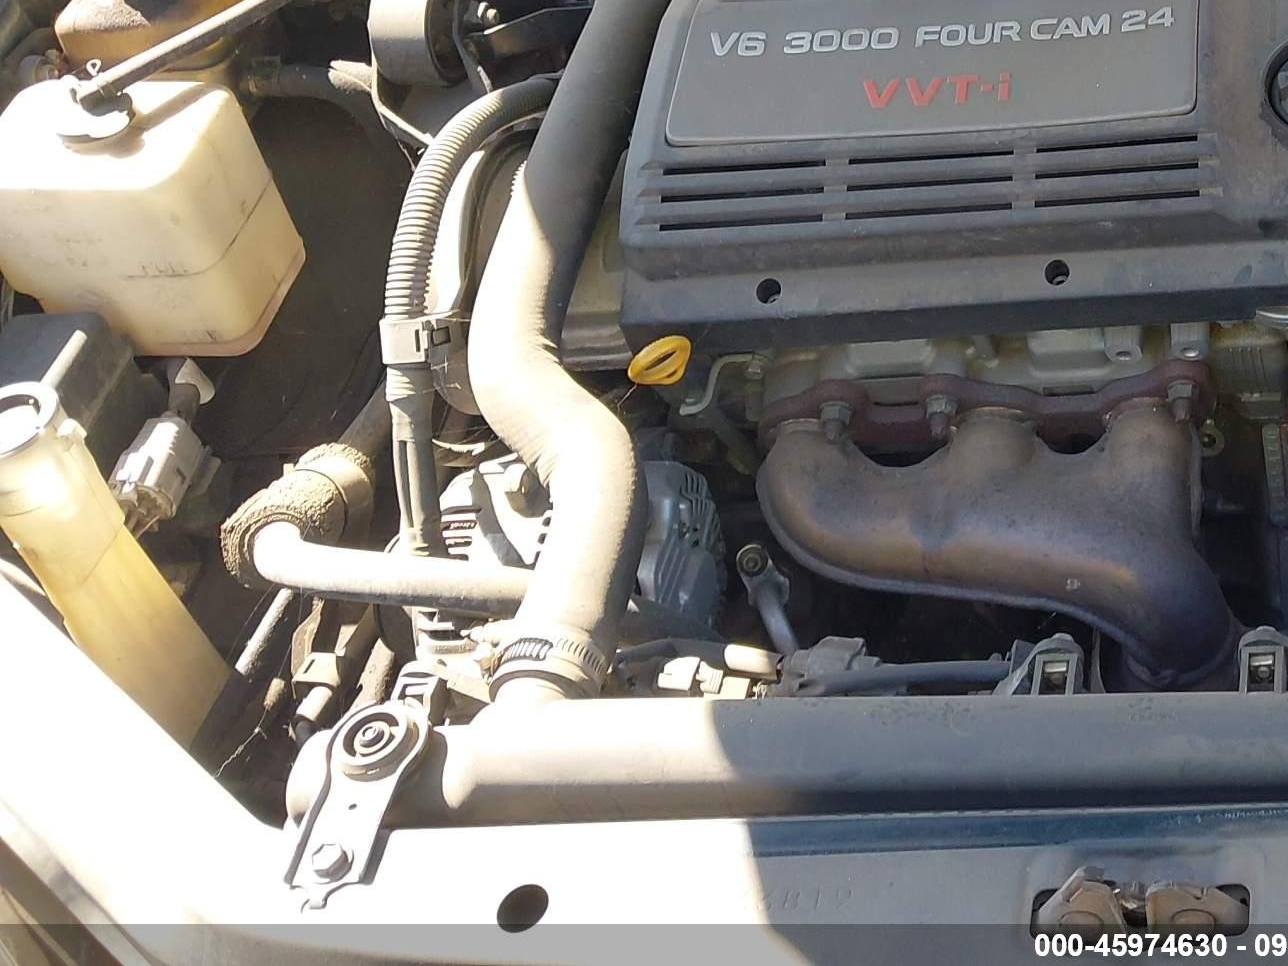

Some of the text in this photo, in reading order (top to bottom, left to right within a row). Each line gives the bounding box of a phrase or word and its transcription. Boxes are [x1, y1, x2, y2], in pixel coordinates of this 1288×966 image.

[711, 6, 1175, 56] V6 3000 FOUR CAM 24
[863, 72, 1013, 109] VVT-i
